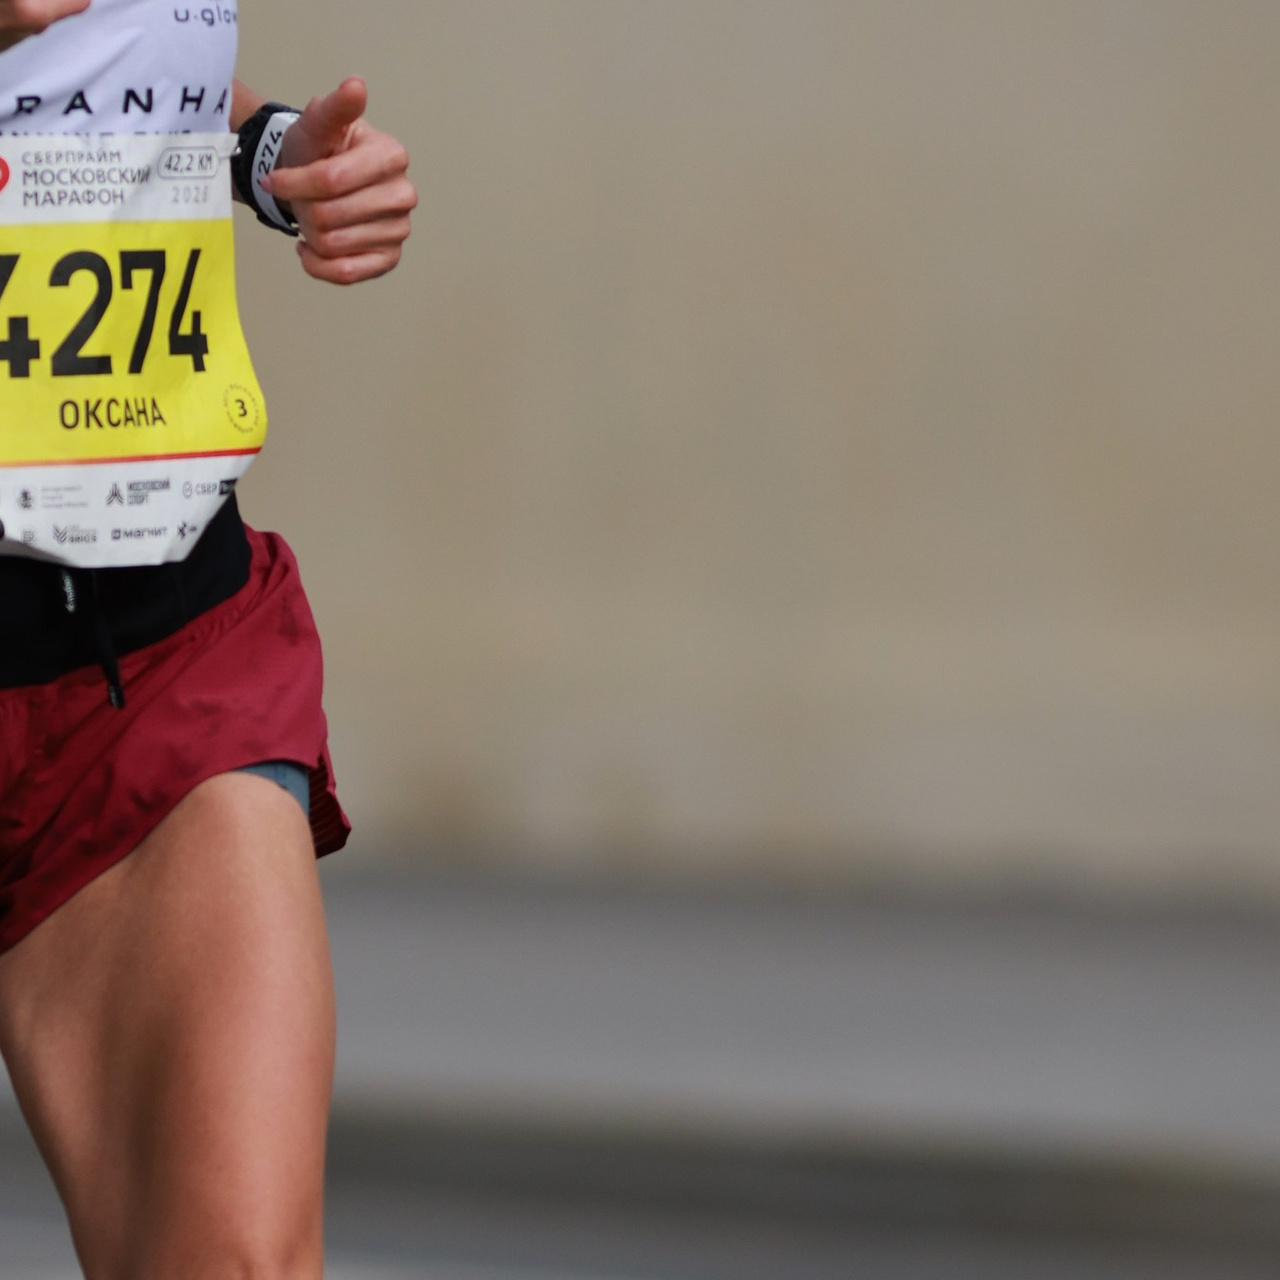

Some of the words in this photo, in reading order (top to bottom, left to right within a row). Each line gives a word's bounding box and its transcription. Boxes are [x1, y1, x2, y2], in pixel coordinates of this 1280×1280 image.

[21, 148, 121, 166] СБЕРПРАЙМ
[164, 153, 194, 173] 42,2
[257, 129, 283, 186] 274
[21, 164, 151, 186] МОСКОВСКИЙ
[22, 188, 126, 208] МАРАФОН
[58, 397, 167, 430] ОКСАНА
[234, 398, 248, 418] 3
